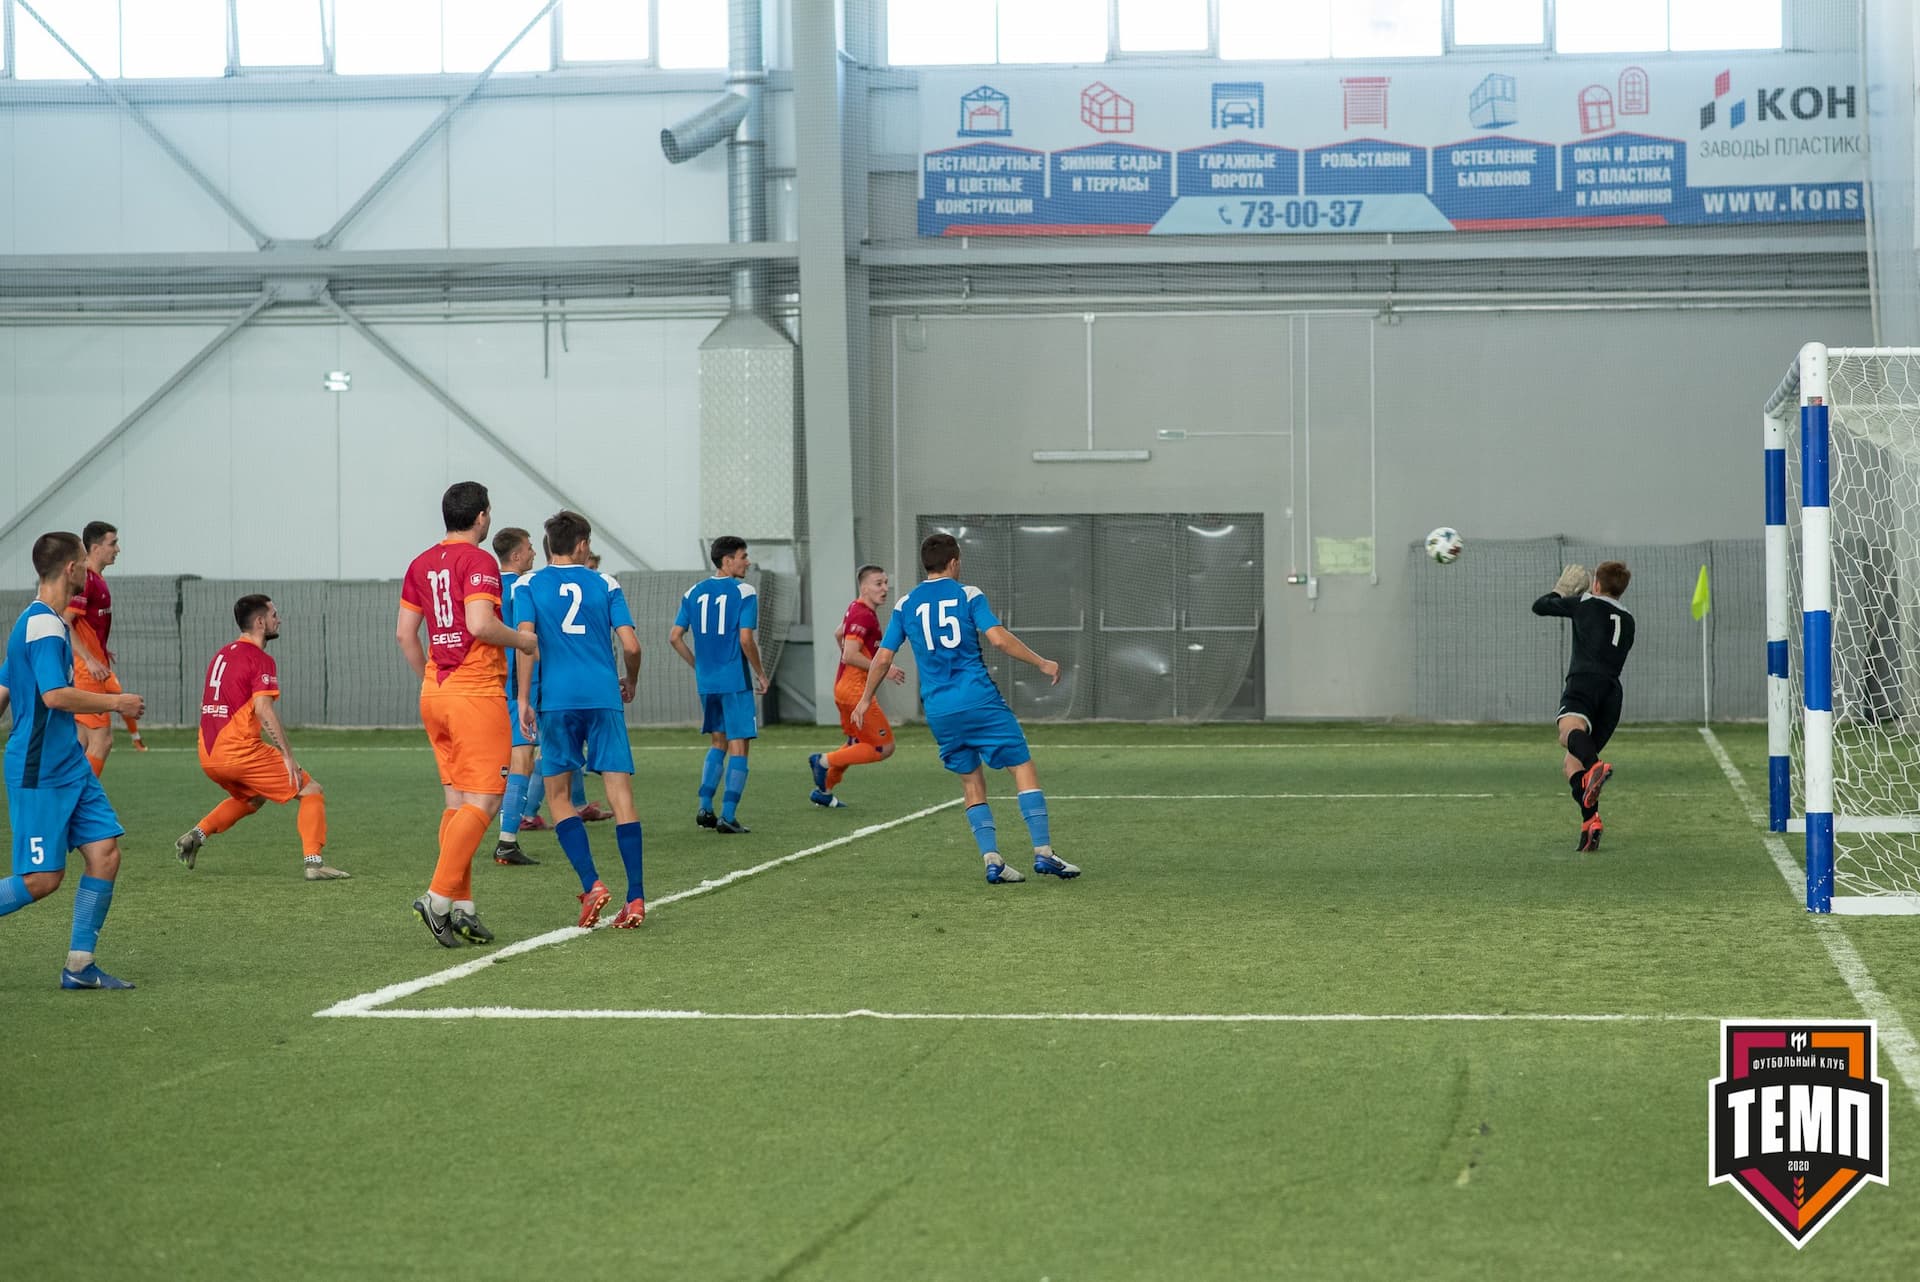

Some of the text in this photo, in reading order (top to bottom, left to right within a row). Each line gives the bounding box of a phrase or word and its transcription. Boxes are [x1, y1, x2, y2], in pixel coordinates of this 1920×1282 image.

[1451, 148, 1537, 166] ОСТЕКЛЕНИЕ
[1573, 145, 1674, 163] ОКНА И ДВЕРИ
[1700, 139, 1769, 159] ЗАВОДЫ
[926, 155, 1043, 173] НЕСТАНДАРТНЫЕ
[1060, 155, 1163, 172] ЗИМНИЕ САДЫ
[1199, 153, 1277, 169] ГАРАЖНЫЕ
[1320, 152, 1411, 168] РОЛЬСТАВНИ
[1072, 176, 1149, 192] И ТЕРРАСЫ
[1211, 173, 1264, 189] ВОРОТА
[1457, 171, 1531, 187] БАЛКОНОВ
[1576, 167, 1671, 184] ИЗ ПЛАСТИКА
[946, 176, 1023, 194] И ЦВЕТНЫЕ
[1576, 188, 1672, 206] И АЛЮМИНИЯ
[935, 199, 1034, 216] КОНСТРУКЦИИ
[1240, 200, 1363, 228] 73-00-37
[427, 569, 454, 628] 13
[559, 582, 586, 635] 2
[697, 593, 728, 635] 11
[915, 599, 962, 651] 15
[1609, 613, 1621, 647] 1
[209, 654, 227, 701] 4
[29, 836, 45, 865] 5
